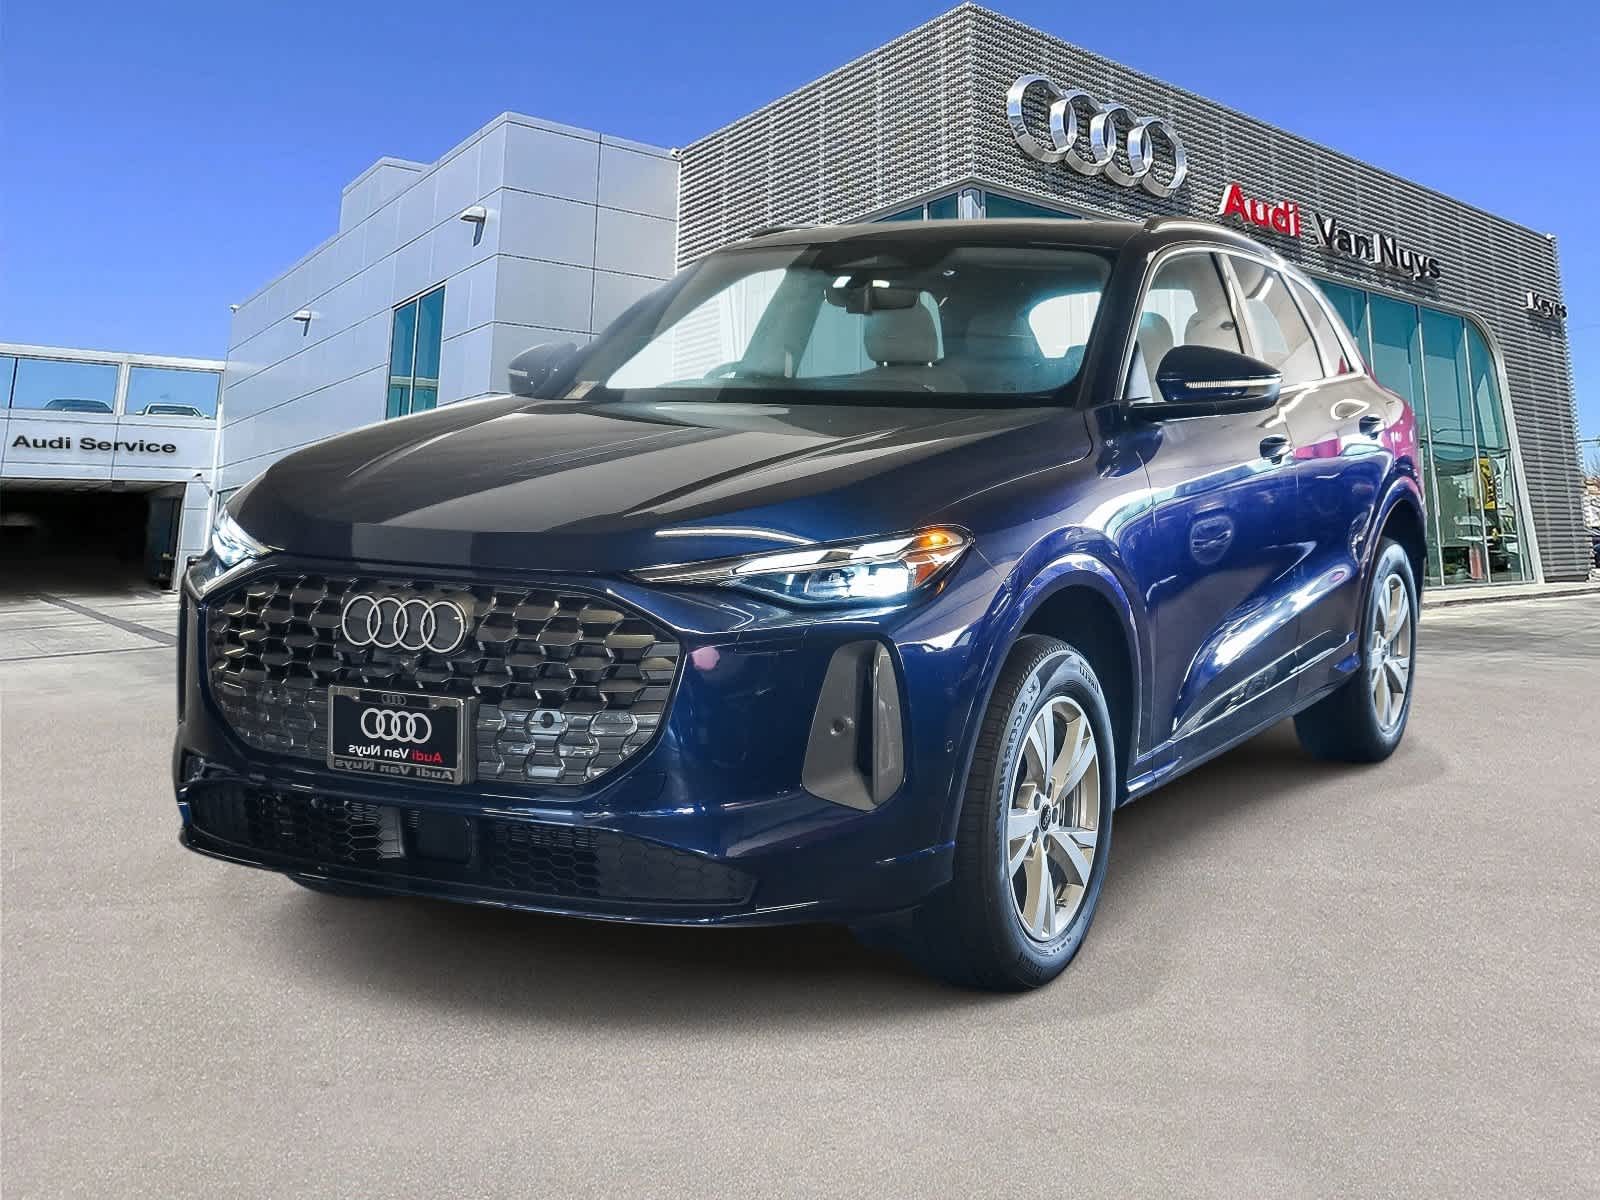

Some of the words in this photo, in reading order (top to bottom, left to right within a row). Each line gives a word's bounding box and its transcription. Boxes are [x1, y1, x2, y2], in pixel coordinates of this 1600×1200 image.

[1218, 182, 1302, 238] Audi
[1311, 212, 1371, 260] Van
[1373, 233, 1441, 281] Nuys
[11, 435, 71, 449] Audi
[79, 437, 177, 454] Service
